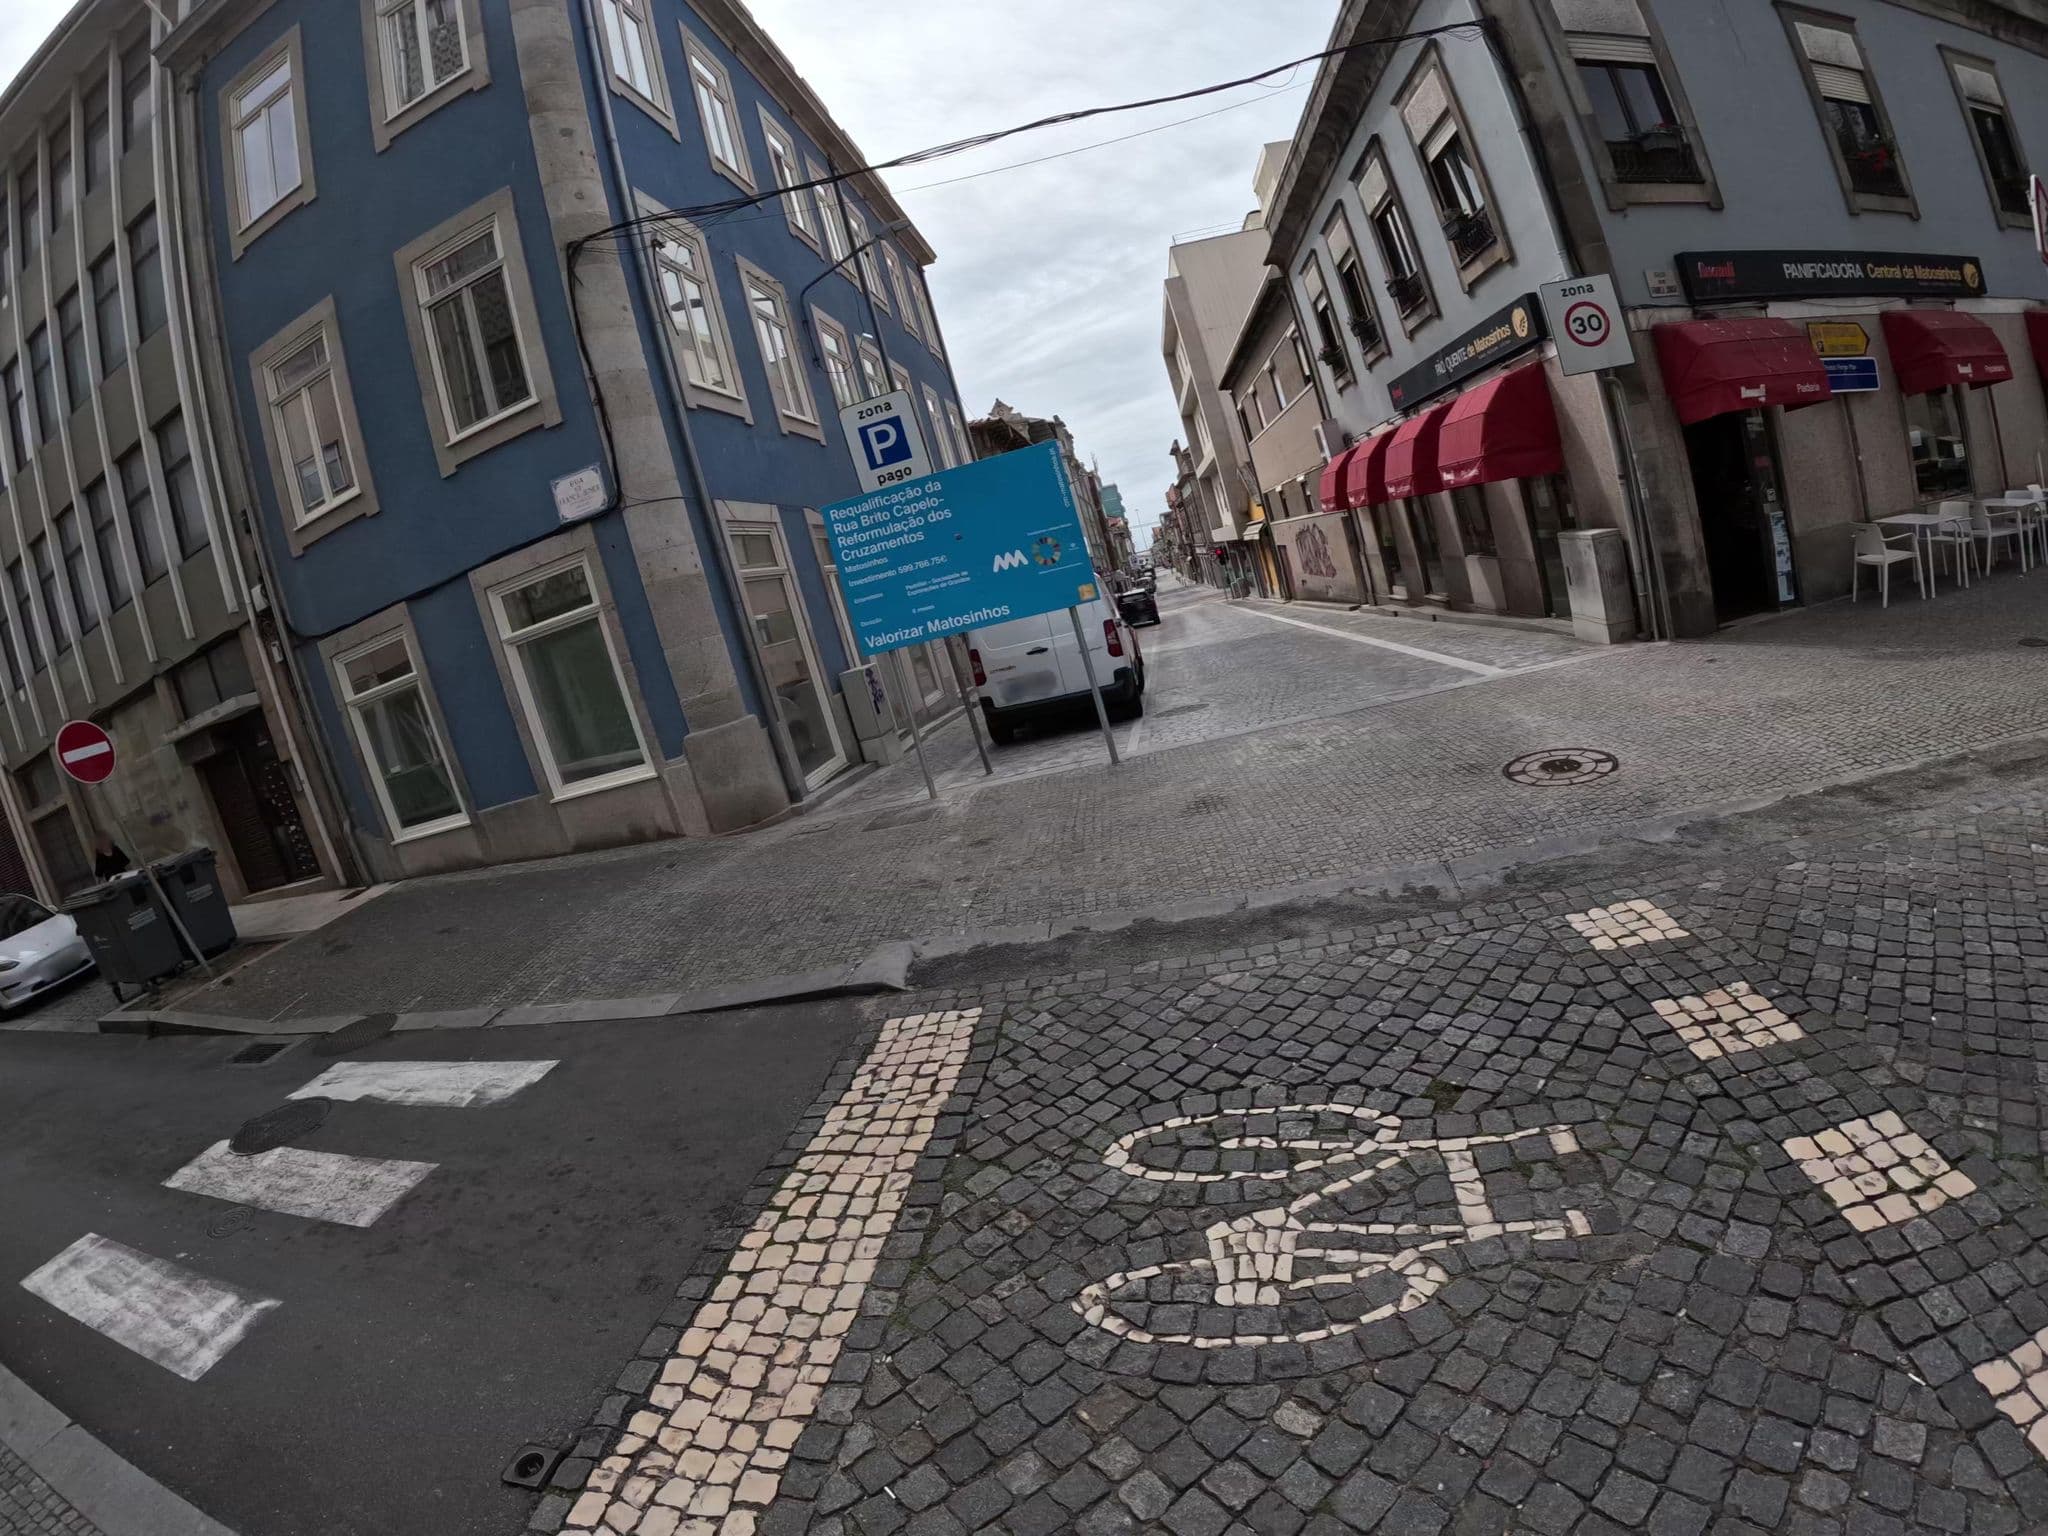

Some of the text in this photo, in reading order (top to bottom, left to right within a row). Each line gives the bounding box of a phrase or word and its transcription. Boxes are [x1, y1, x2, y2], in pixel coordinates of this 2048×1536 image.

[1782, 262, 1962, 281] PANIFICADORA Central de Matosinhos
[1560, 283, 1595, 298] zona
[1572, 313, 1602, 335] 30
[1445, 347, 1468, 374] QUENTE
[1473, 324, 1511, 354] Matosinhos
[857, 401, 893, 420] zona
[866, 423, 897, 465] P
[877, 466, 912, 487] pago
[829, 481, 942, 522] Requalificação da
[833, 523, 859, 535] Rua
[860, 510, 891, 528] Brito
[837, 508, 952, 548] Reformulação dos
[841, 531, 925, 562] Cruzamentos
[844, 557, 889, 573] Matosinhos
[848, 568, 897, 587] Investimento
[864, 604, 1010, 648] Valorizar Matosinhos
